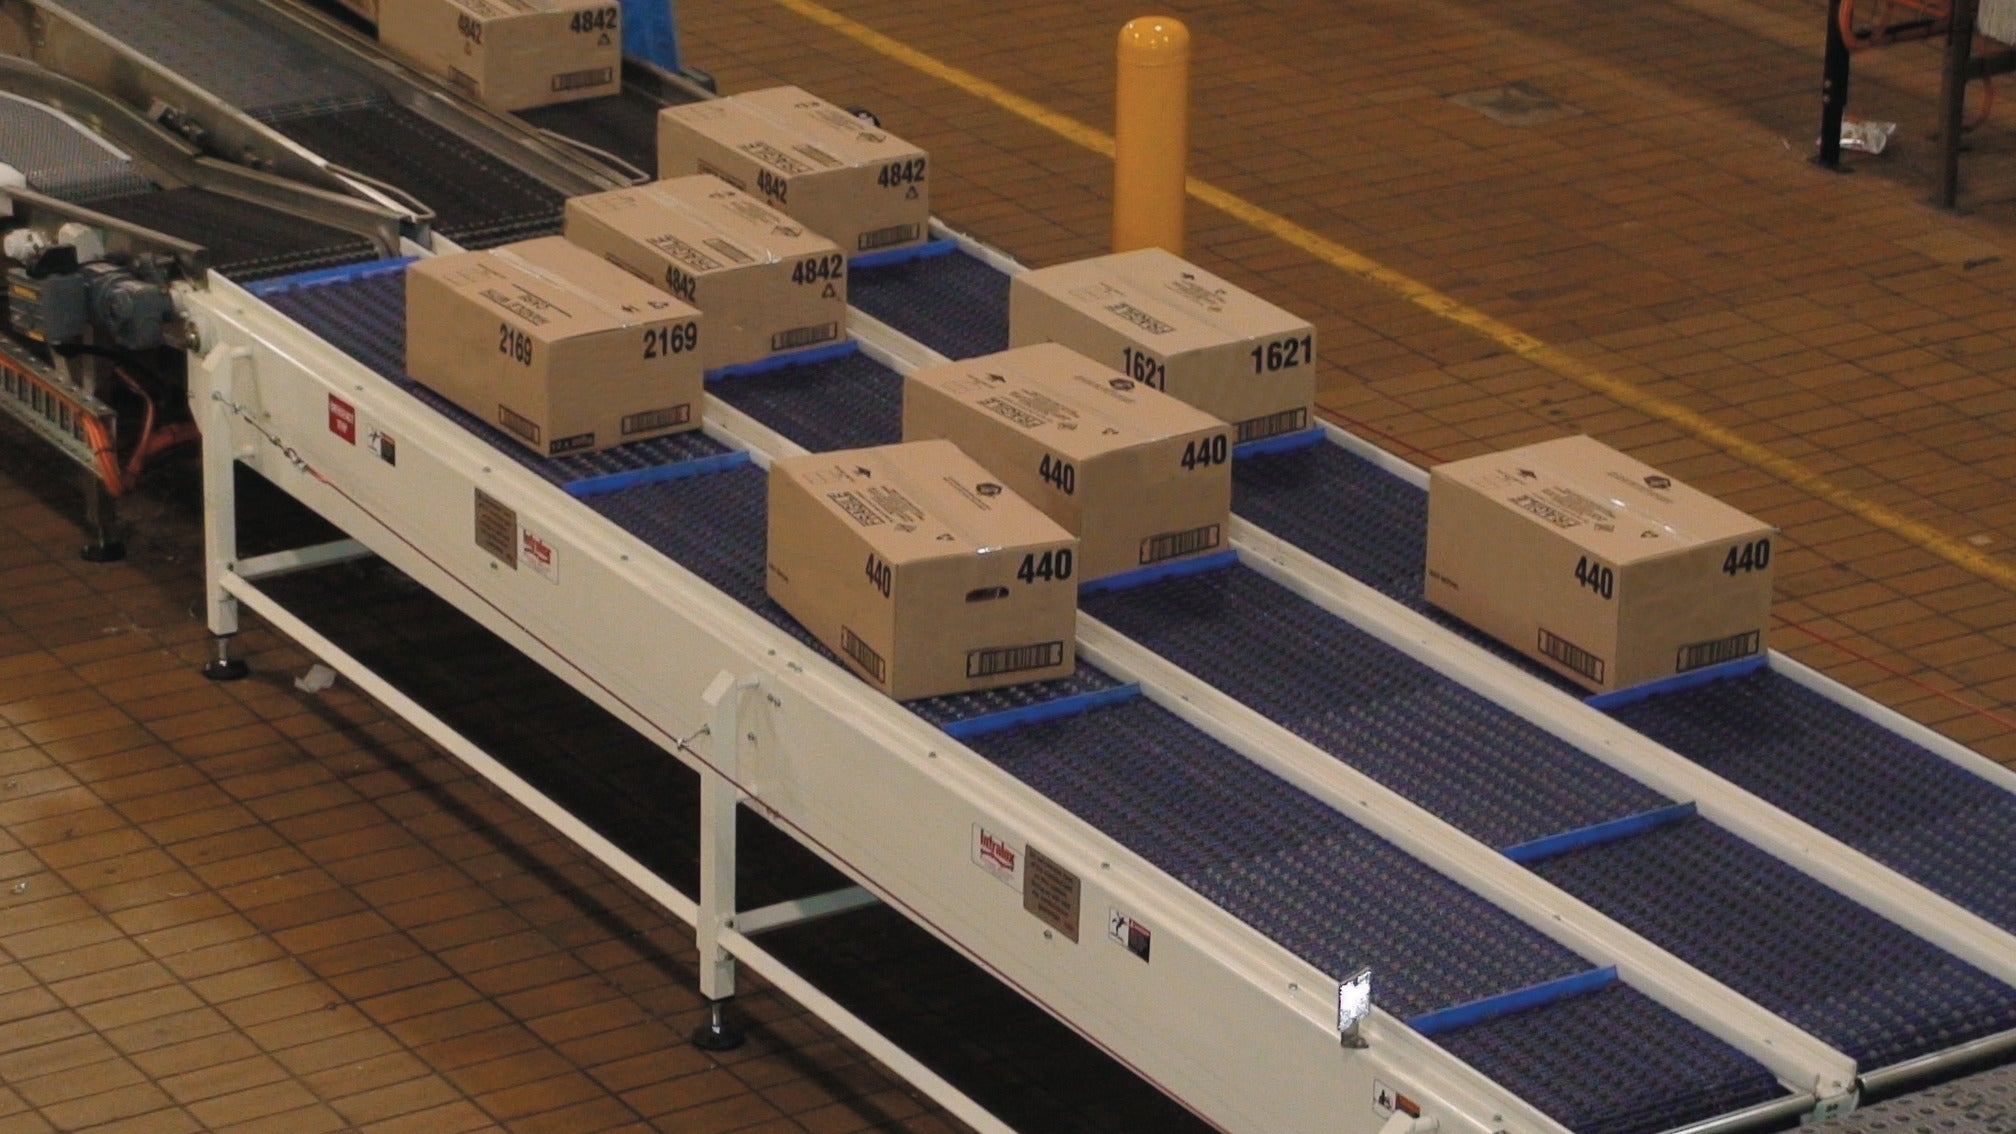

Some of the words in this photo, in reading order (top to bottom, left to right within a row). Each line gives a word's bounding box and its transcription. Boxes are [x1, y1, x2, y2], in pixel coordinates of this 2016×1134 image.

[569, 7, 618, 34] 4842
[757, 168, 788, 204] 4842
[877, 158, 926, 189] 4842
[665, 263, 697, 303] 4842
[791, 253, 843, 286] 4842
[499, 323, 533, 367] 2169
[643, 321, 698, 360] 2169
[1250, 335, 1312, 375] 1621
[1123, 346, 1166, 393] 1621
[1181, 433, 1228, 471] 440
[1039, 452, 1075, 495] 440
[865, 552, 892, 599] 440
[1017, 548, 1073, 584] 440
[1723, 538, 1770, 577] 440
[1574, 555, 1613, 601] 440
